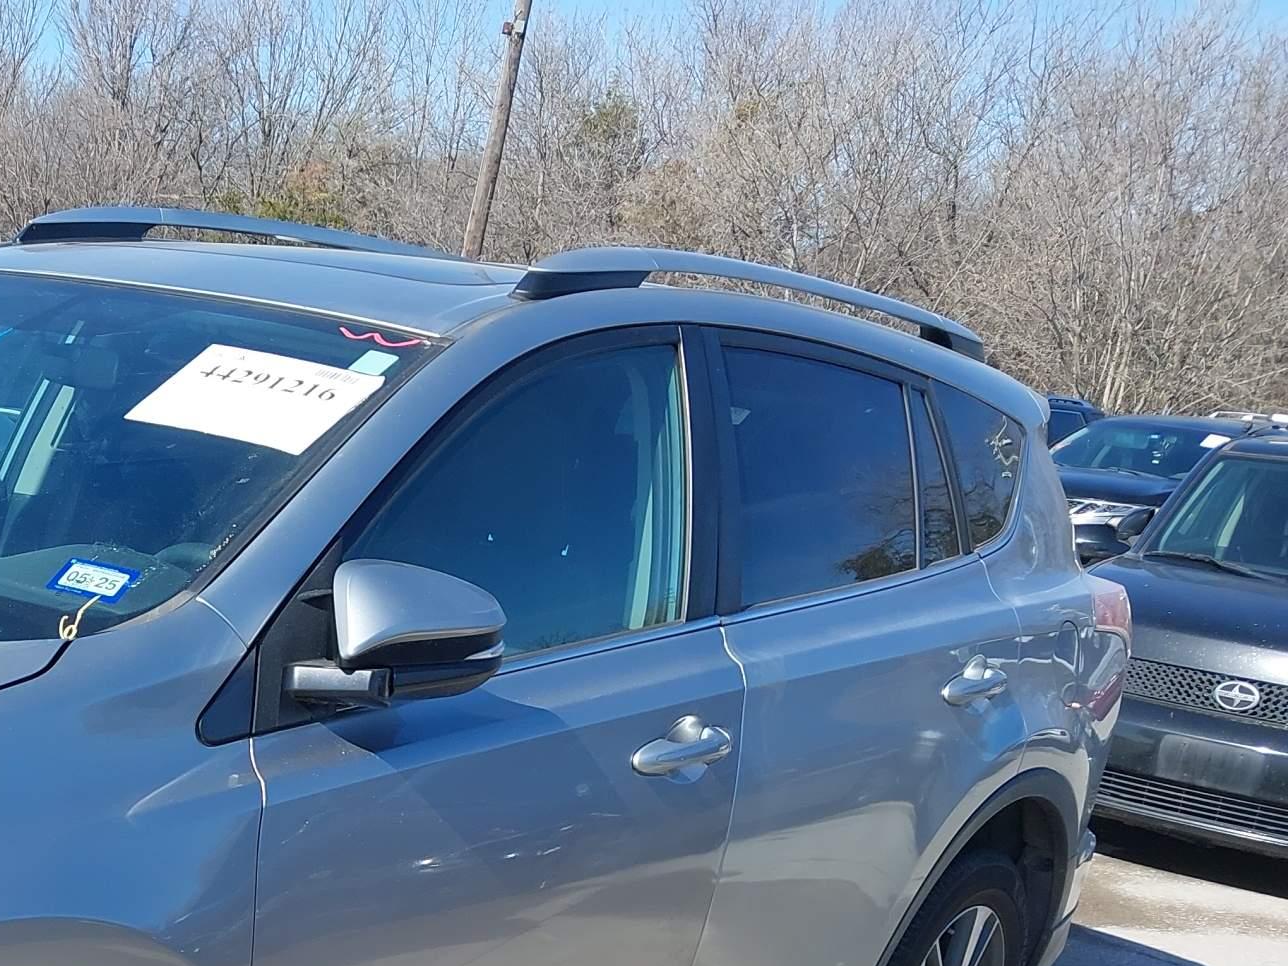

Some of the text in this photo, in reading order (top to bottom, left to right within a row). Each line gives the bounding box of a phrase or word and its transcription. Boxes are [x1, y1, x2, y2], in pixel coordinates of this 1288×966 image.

[199, 364, 337, 402] 44291216
[66, 570, 91, 584] 05
[94, 577, 121, 591] 25
